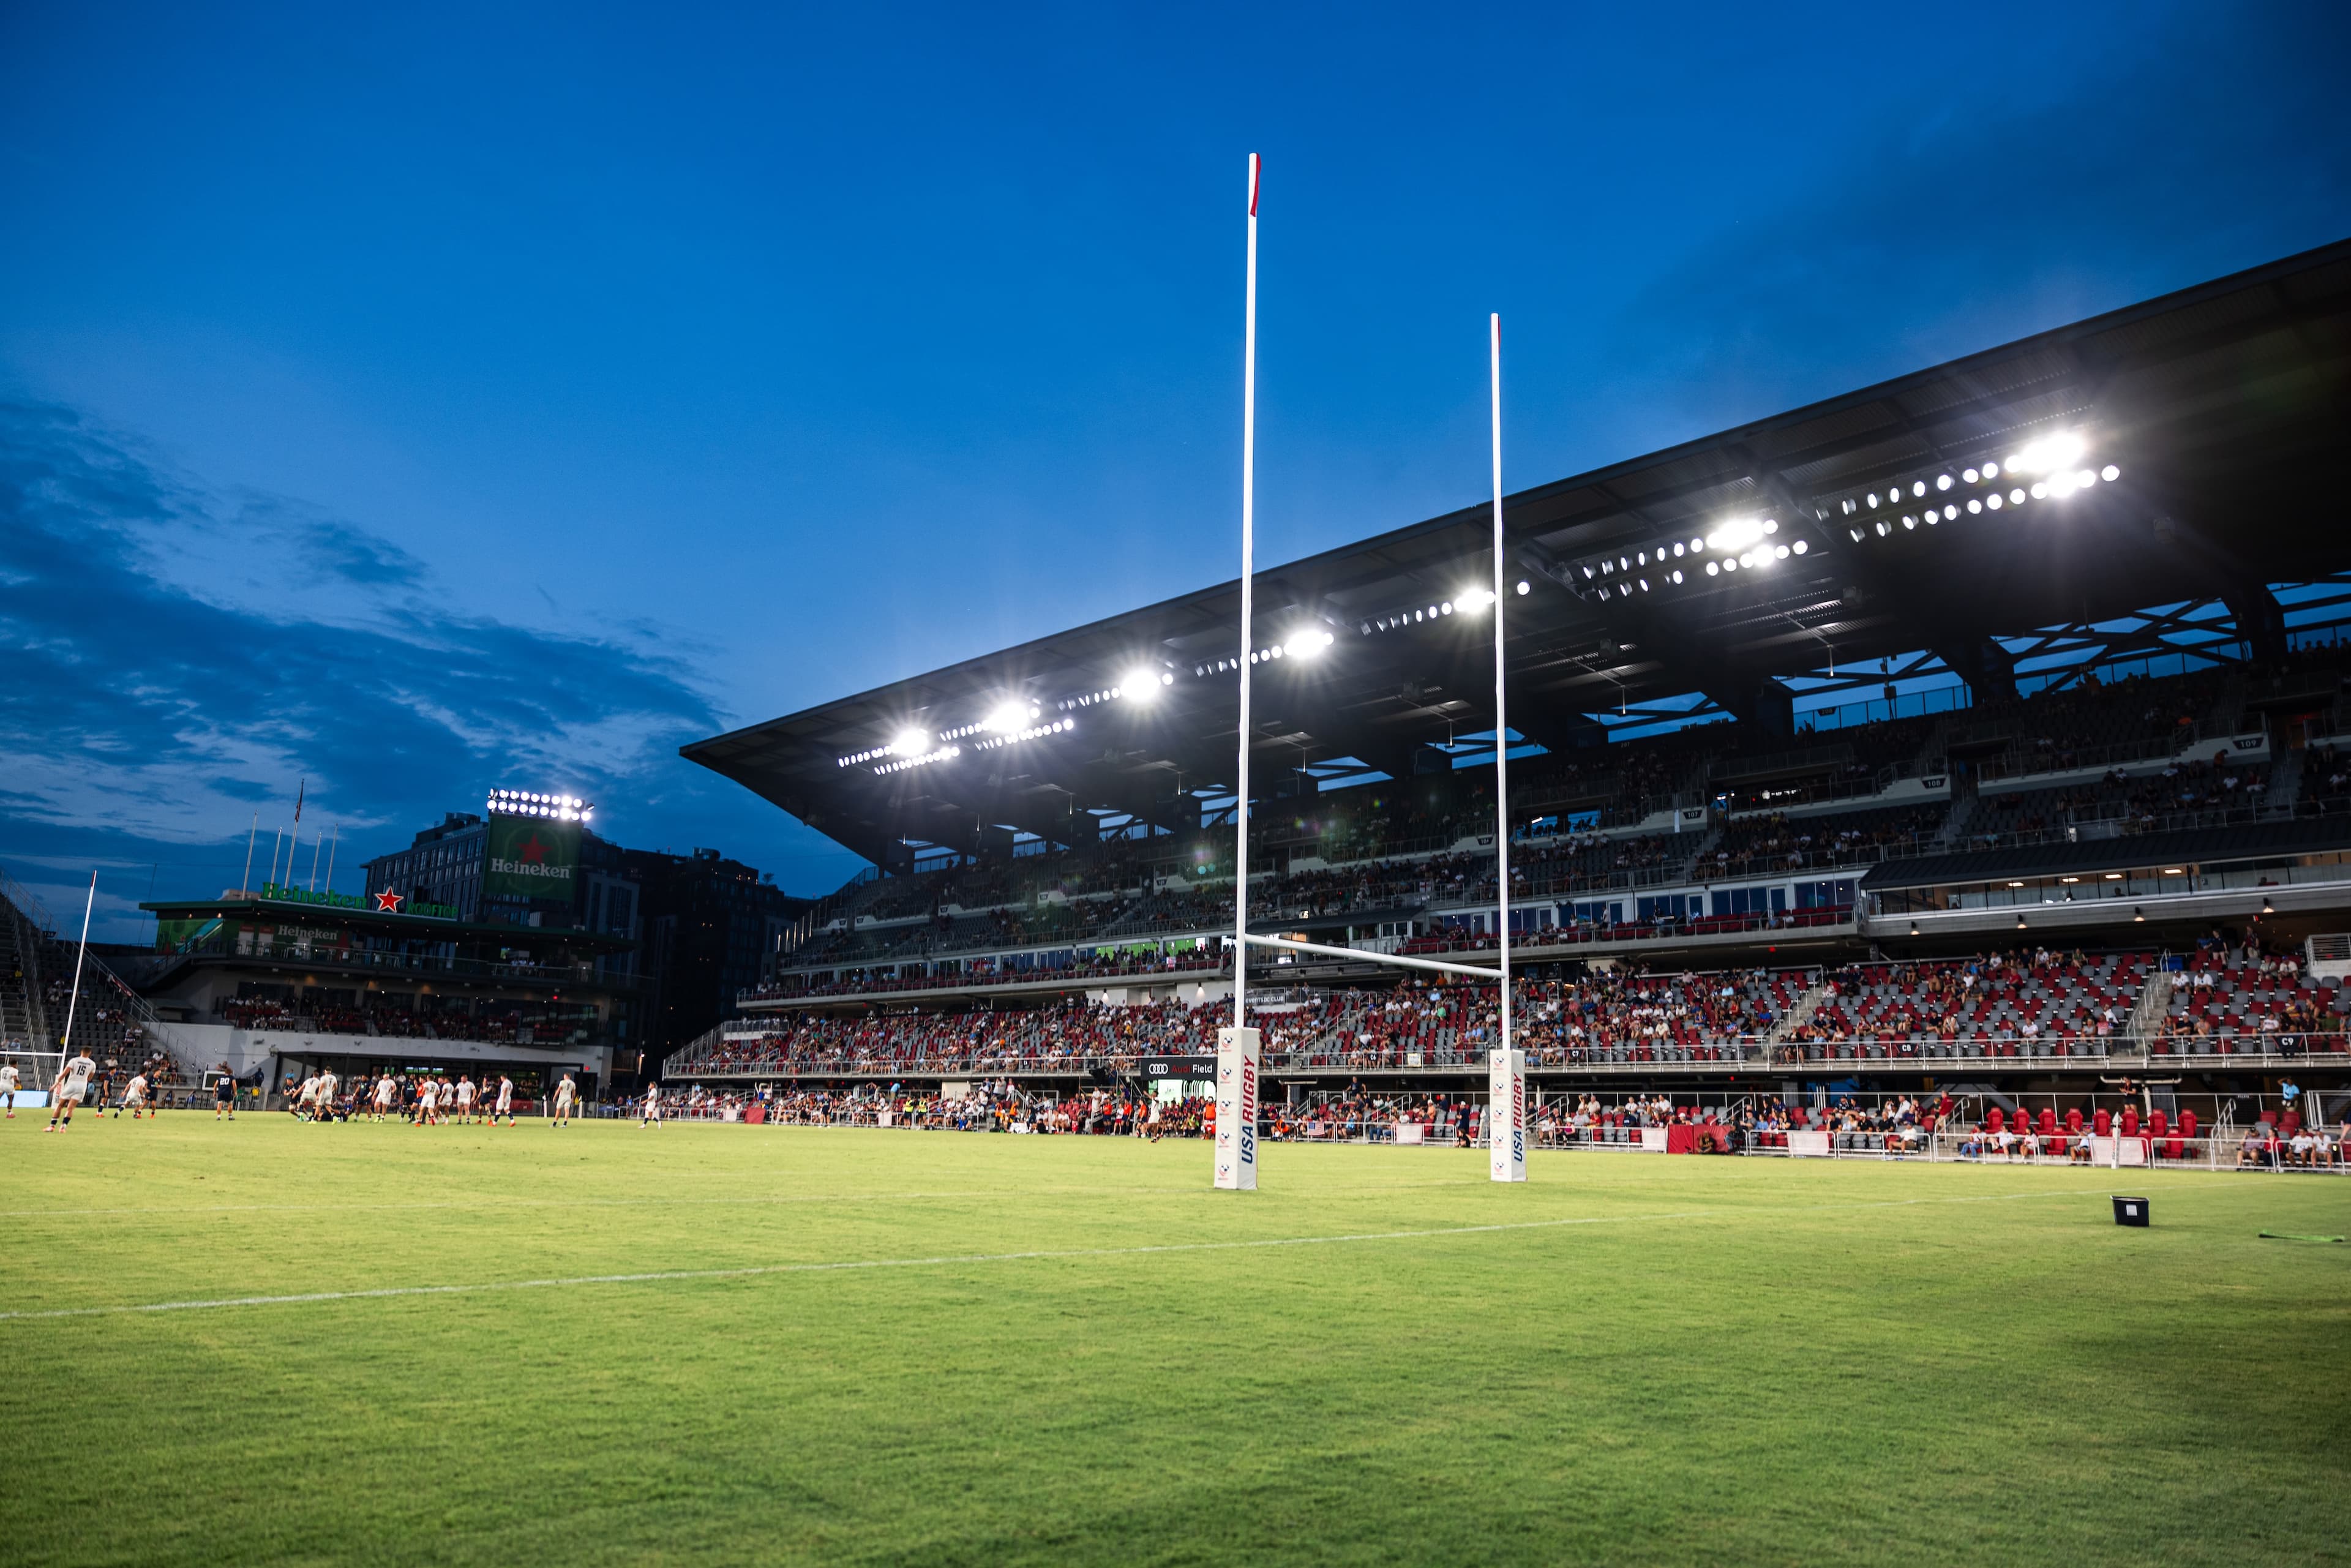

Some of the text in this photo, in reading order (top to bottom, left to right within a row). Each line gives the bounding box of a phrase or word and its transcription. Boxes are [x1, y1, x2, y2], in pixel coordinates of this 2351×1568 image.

[2240, 739, 2257, 748] 109
[491, 858, 570, 879] Heineken
[261, 882, 458, 918] Heineken ROOFTOP
[278, 925, 337, 940] Heineken
[2281, 1037, 2294, 1046] C9
[77, 1065, 86, 1076] 15
[1171, 1063, 1213, 1073] Audi Field
[220, 1077, 230, 1086] 20
[1242, 1053, 1255, 1165] USA RUGBY
[1513, 1072, 1523, 1163] USA RUGBY
